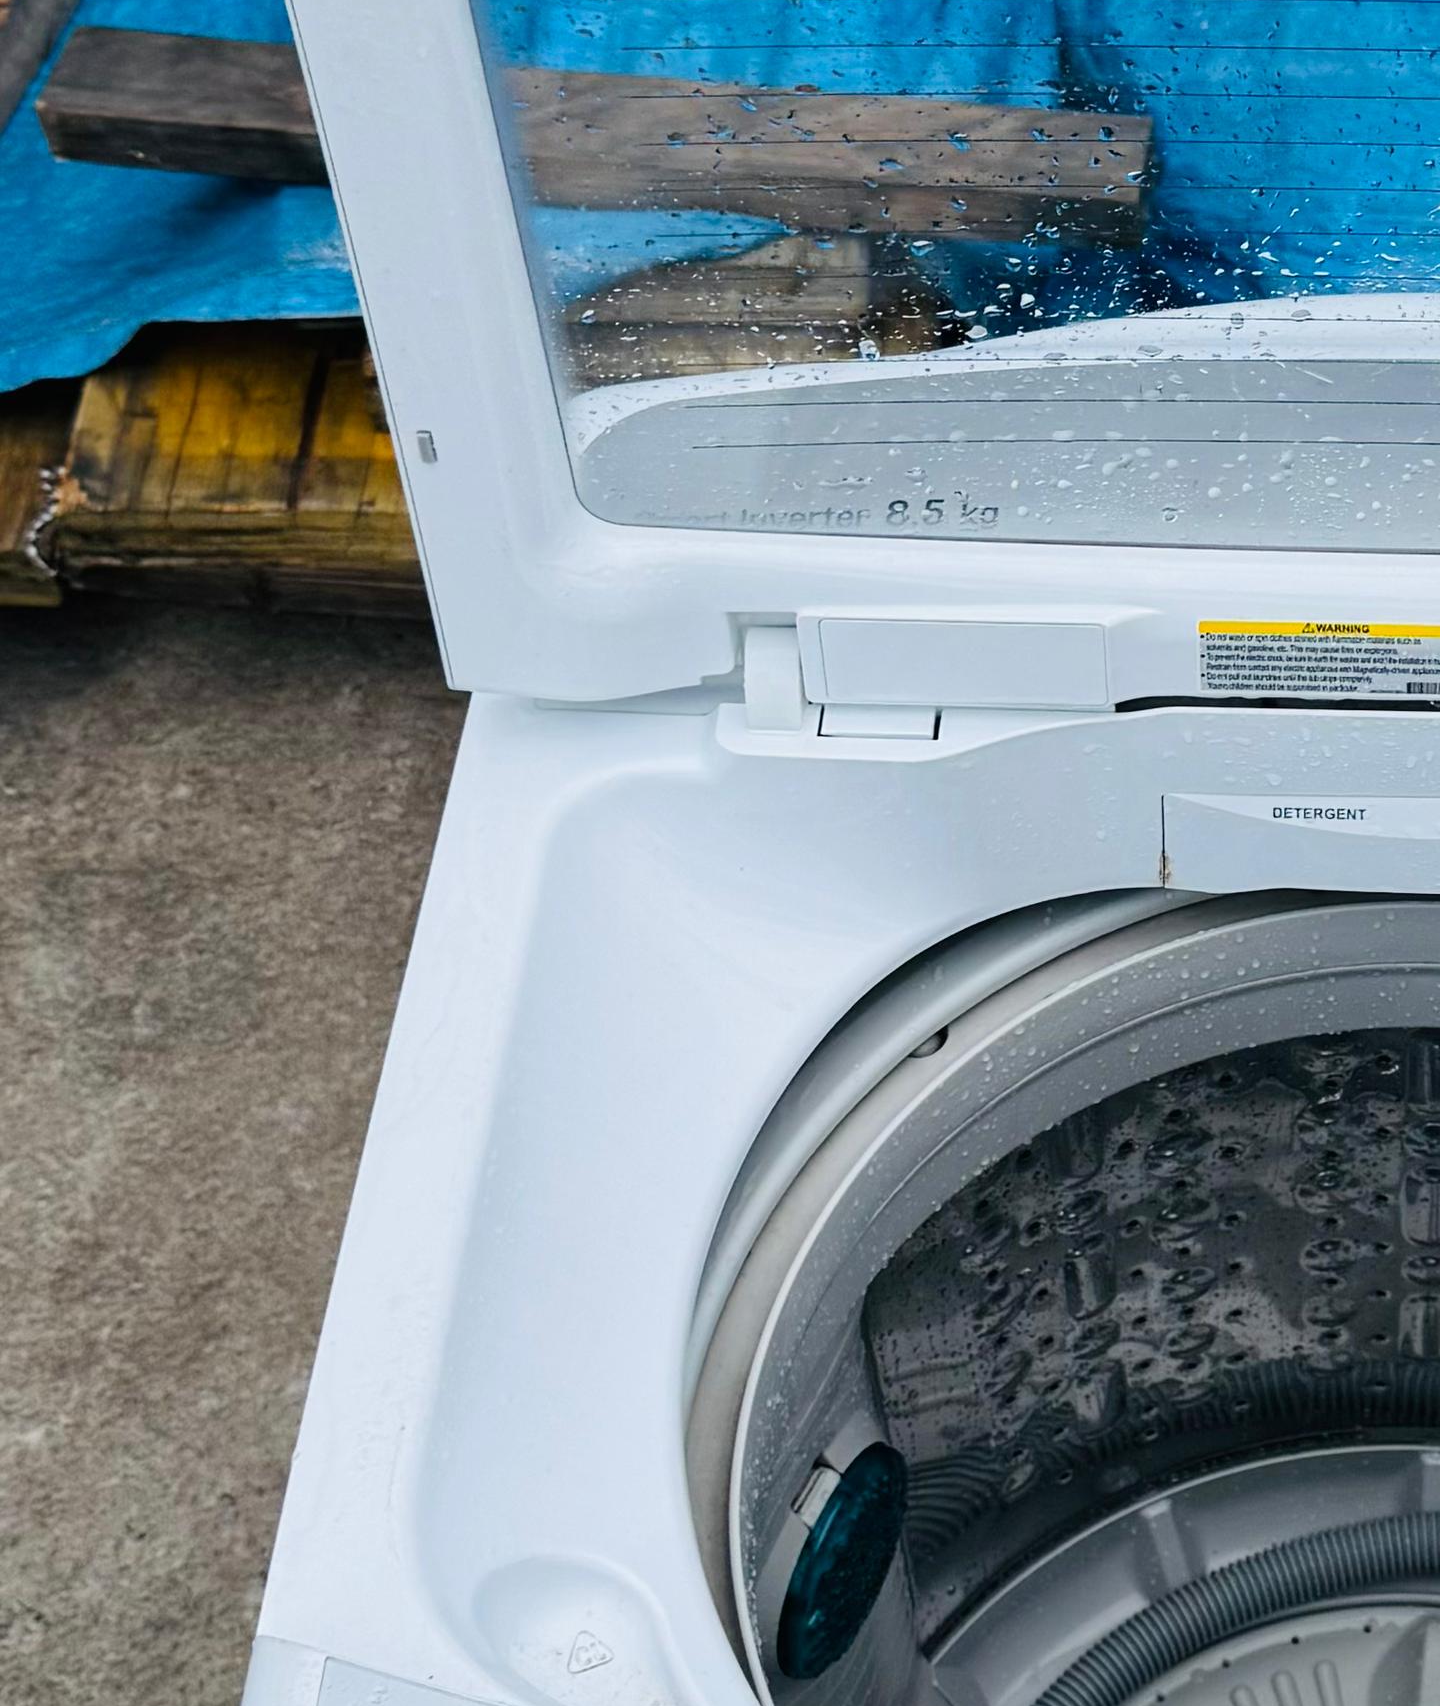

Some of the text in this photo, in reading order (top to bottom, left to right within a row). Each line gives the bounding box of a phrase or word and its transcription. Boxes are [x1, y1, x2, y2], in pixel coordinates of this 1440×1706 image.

[886, 499, 945, 526] 8.5
[1316, 623, 1370, 634] WARNING
[1272, 806, 1367, 821] DETERGENT
